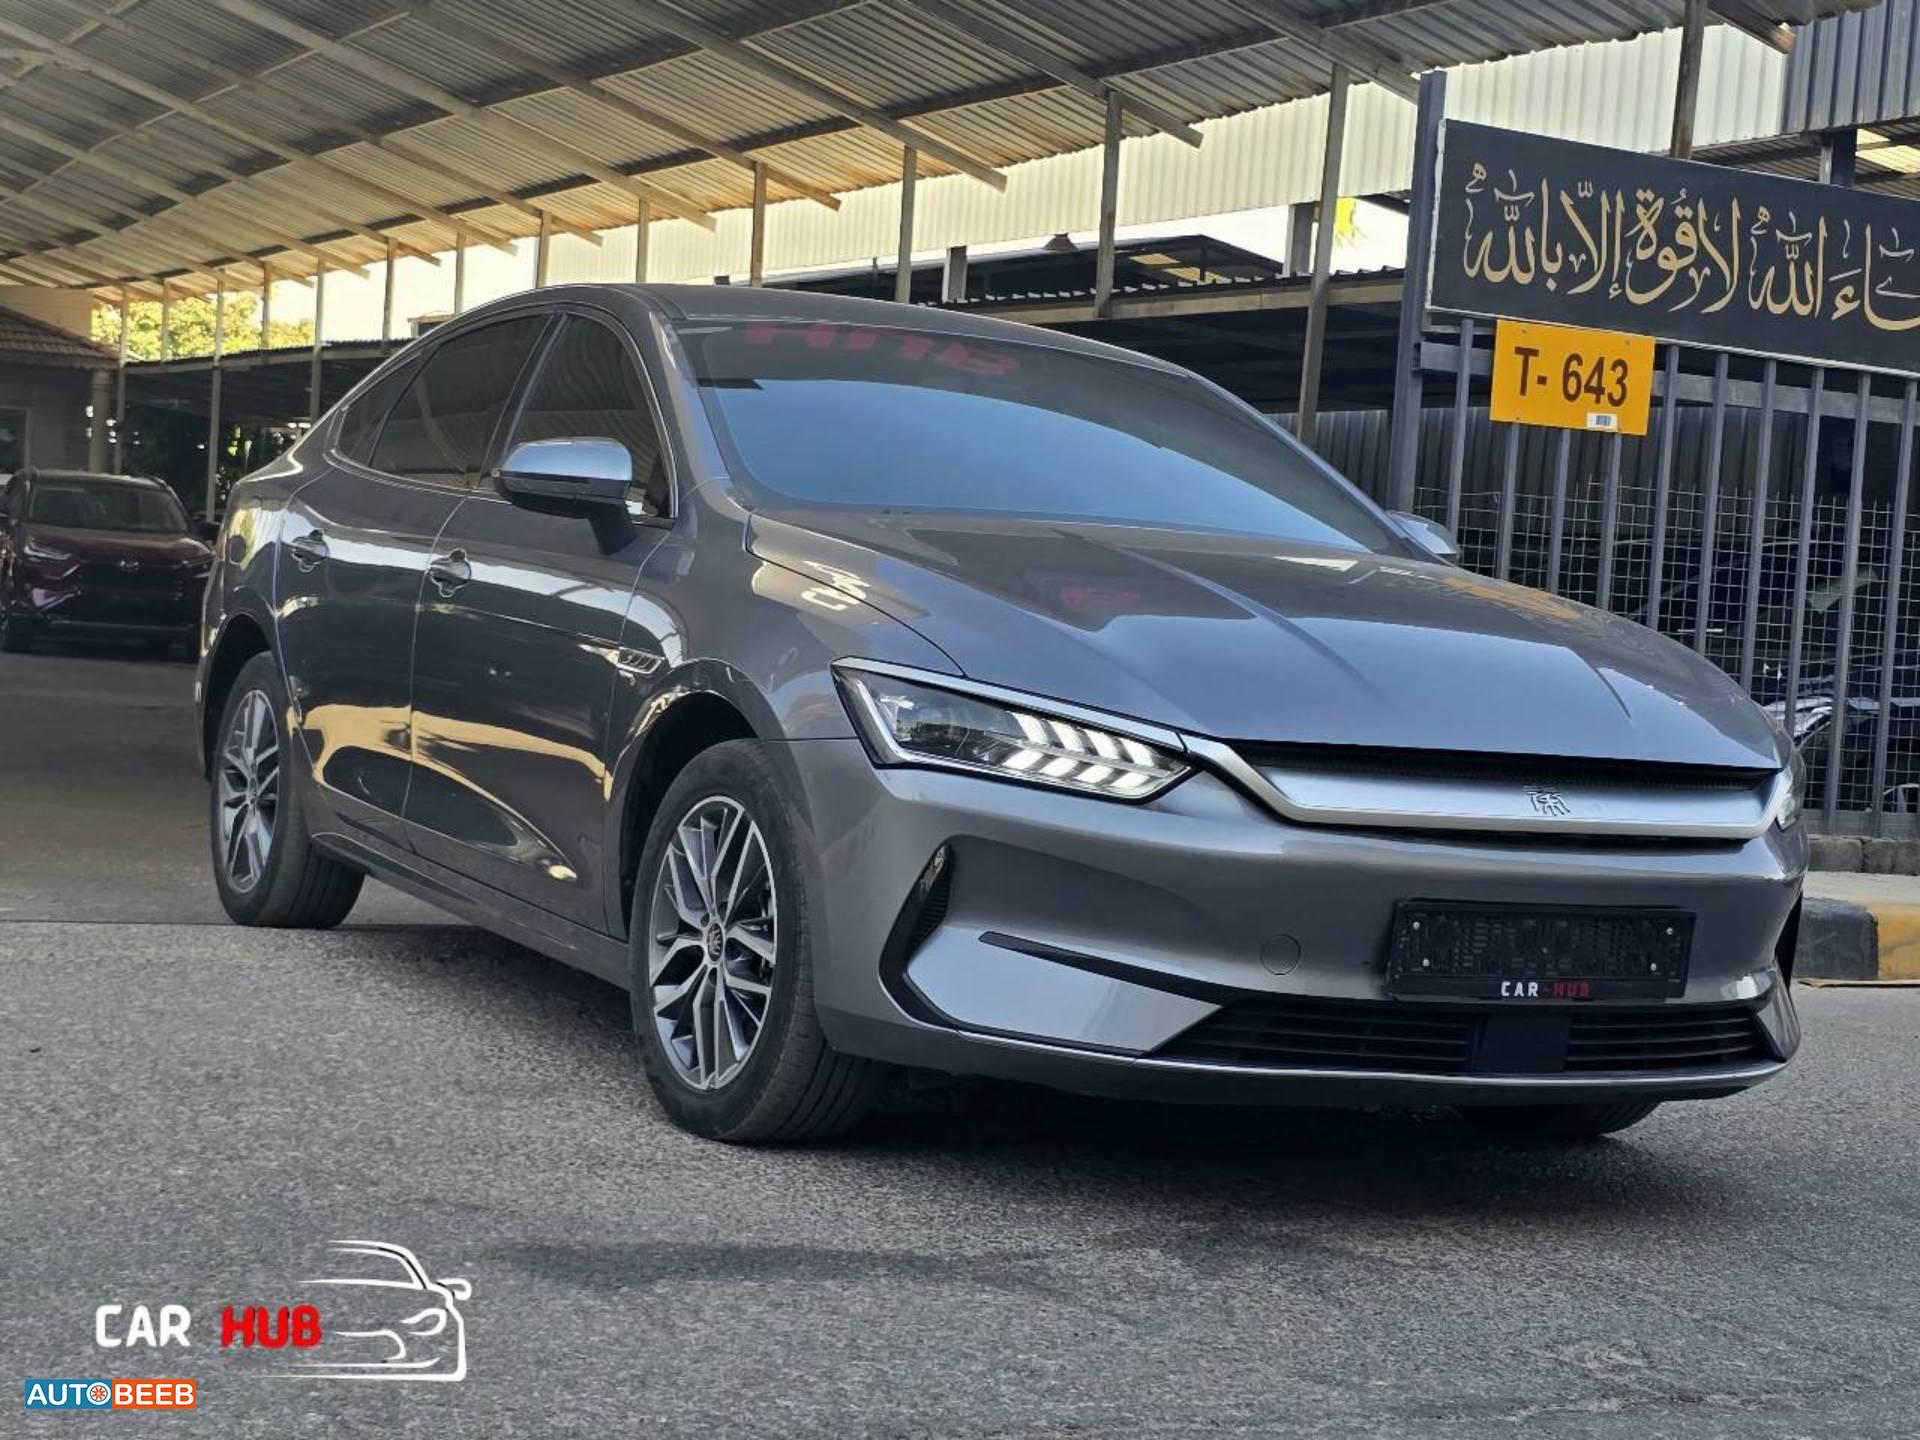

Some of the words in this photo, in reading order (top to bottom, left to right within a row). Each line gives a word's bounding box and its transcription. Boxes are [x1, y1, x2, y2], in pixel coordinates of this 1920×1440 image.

[1749, 206, 1828, 318] الله
[1562, 353, 1629, 407] 643
[1501, 981, 1539, 997] CAR
[1552, 981, 1591, 998] HUB
